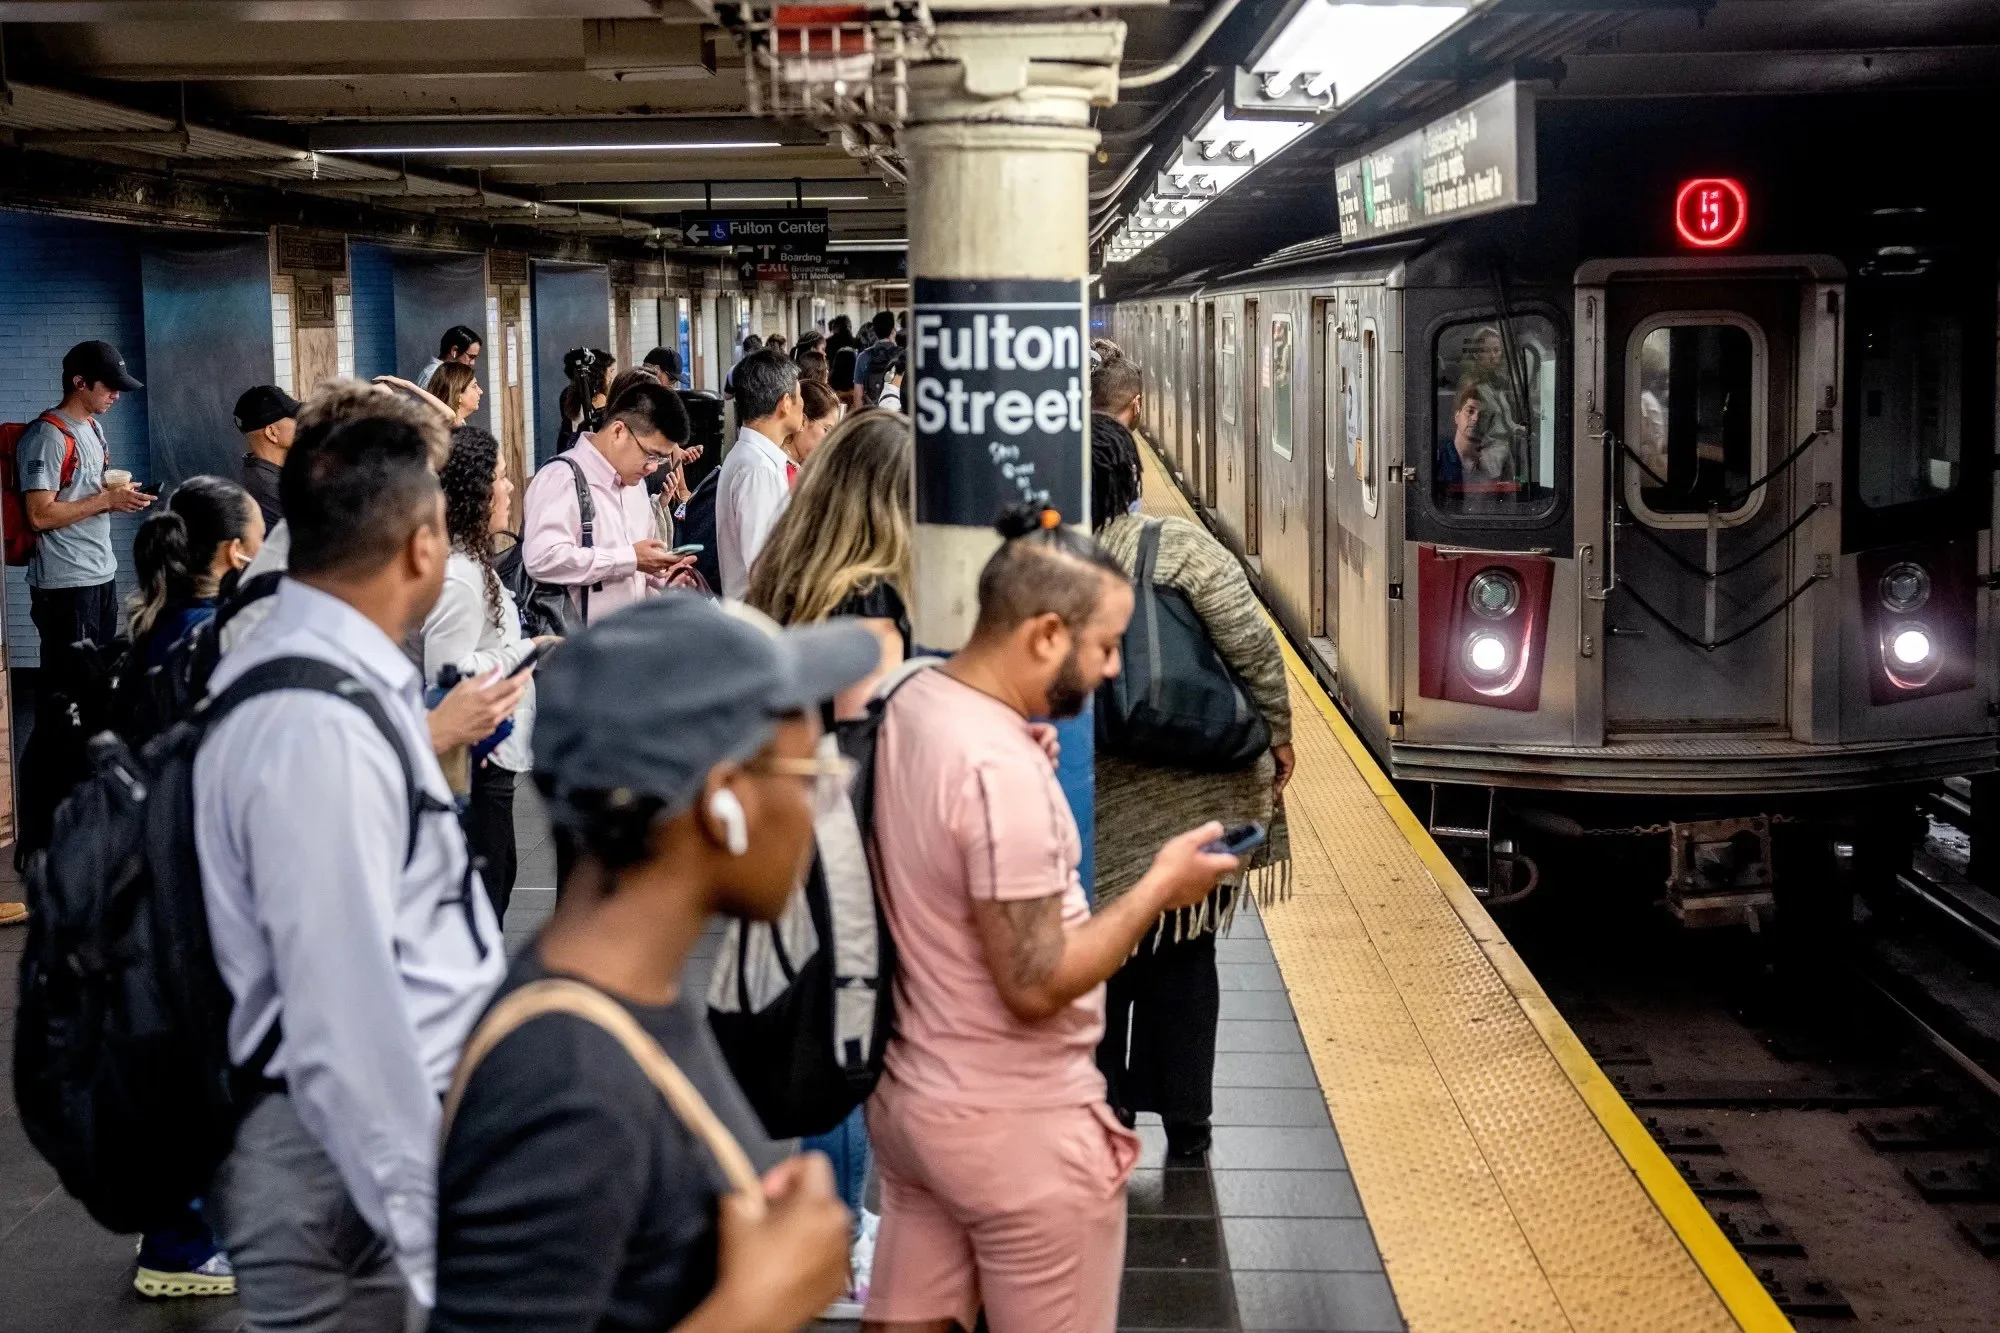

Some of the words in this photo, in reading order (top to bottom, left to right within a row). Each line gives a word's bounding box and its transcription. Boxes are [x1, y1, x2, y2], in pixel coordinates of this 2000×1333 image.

[1701, 190, 1720, 233] 5
[729, 221, 773, 235] Fulton
[778, 220, 826, 234] Center
[780, 252, 822, 264] Boarding
[810, 272, 846, 280] Memorial
[915, 313, 1080, 372] Fulton
[916, 375, 1083, 436] Street
